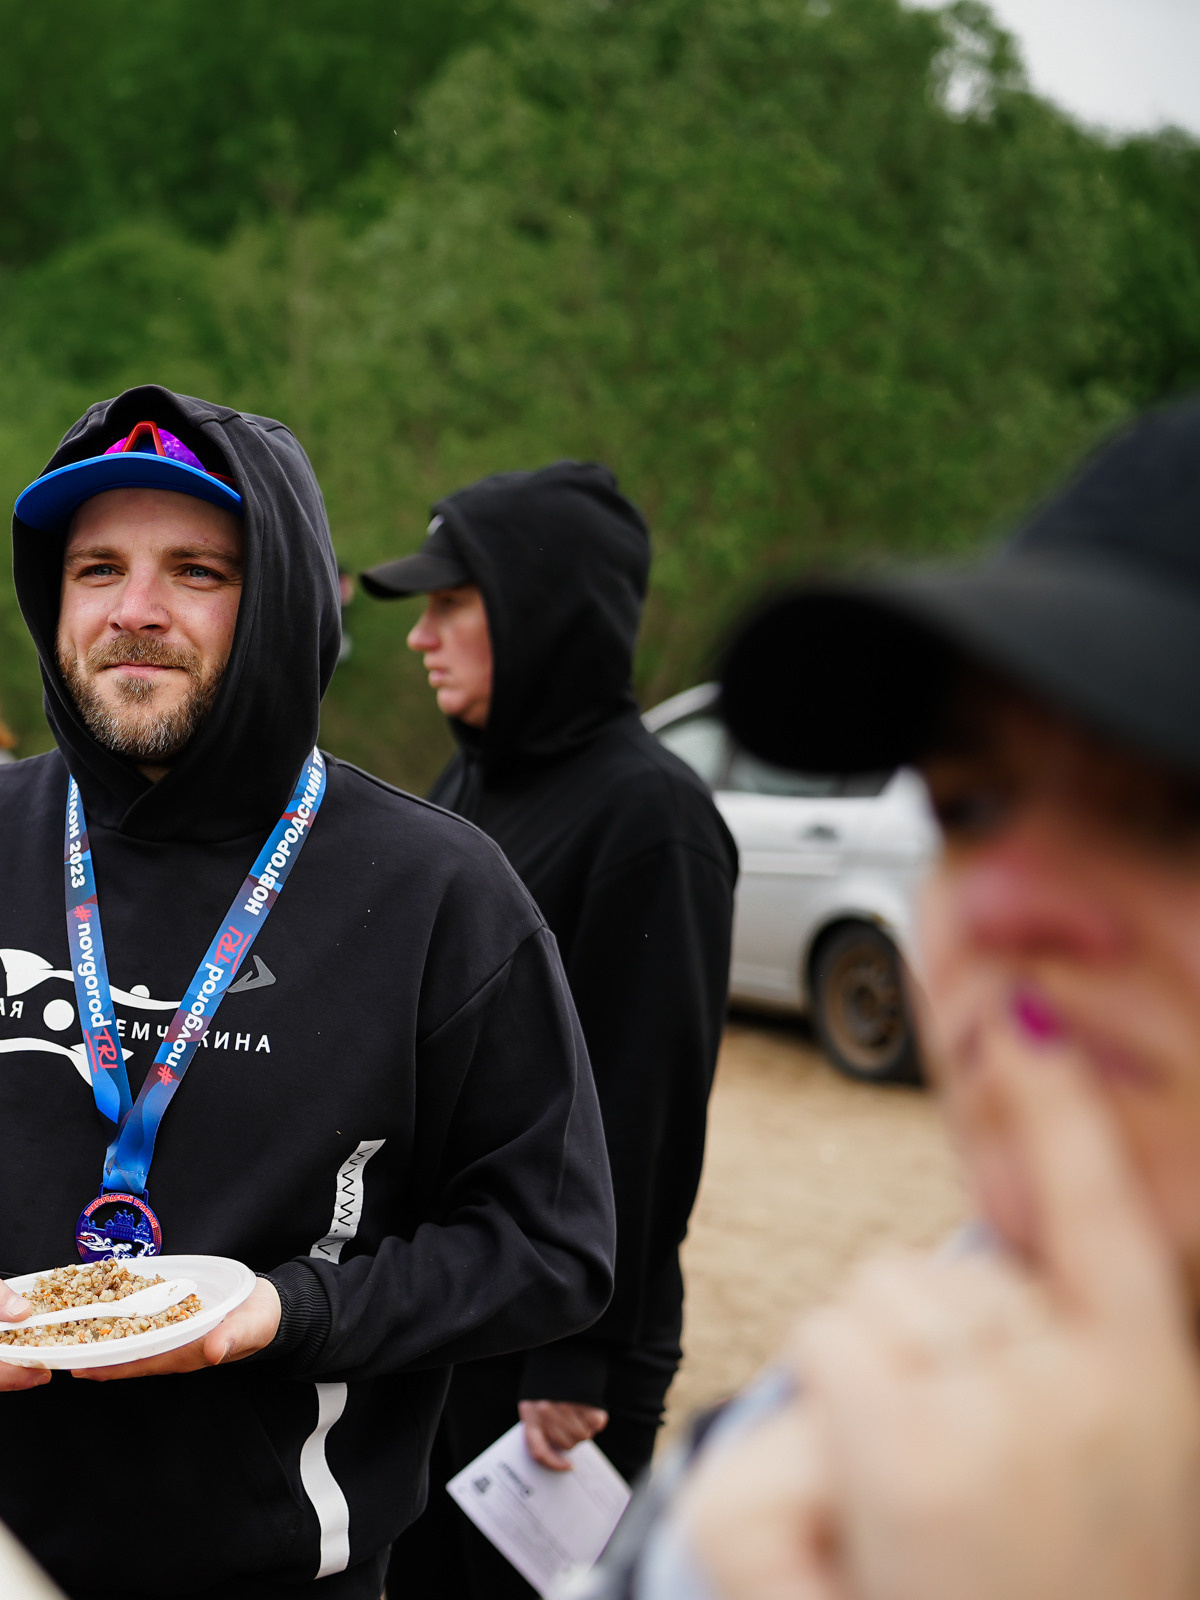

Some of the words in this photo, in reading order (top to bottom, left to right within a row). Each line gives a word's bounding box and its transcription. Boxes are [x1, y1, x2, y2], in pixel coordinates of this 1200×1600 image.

[68, 778, 80, 840] АТЛОН
[69, 840, 86, 889] 2023
[243, 766, 323, 916] НОВГОРОДСКИЙ
